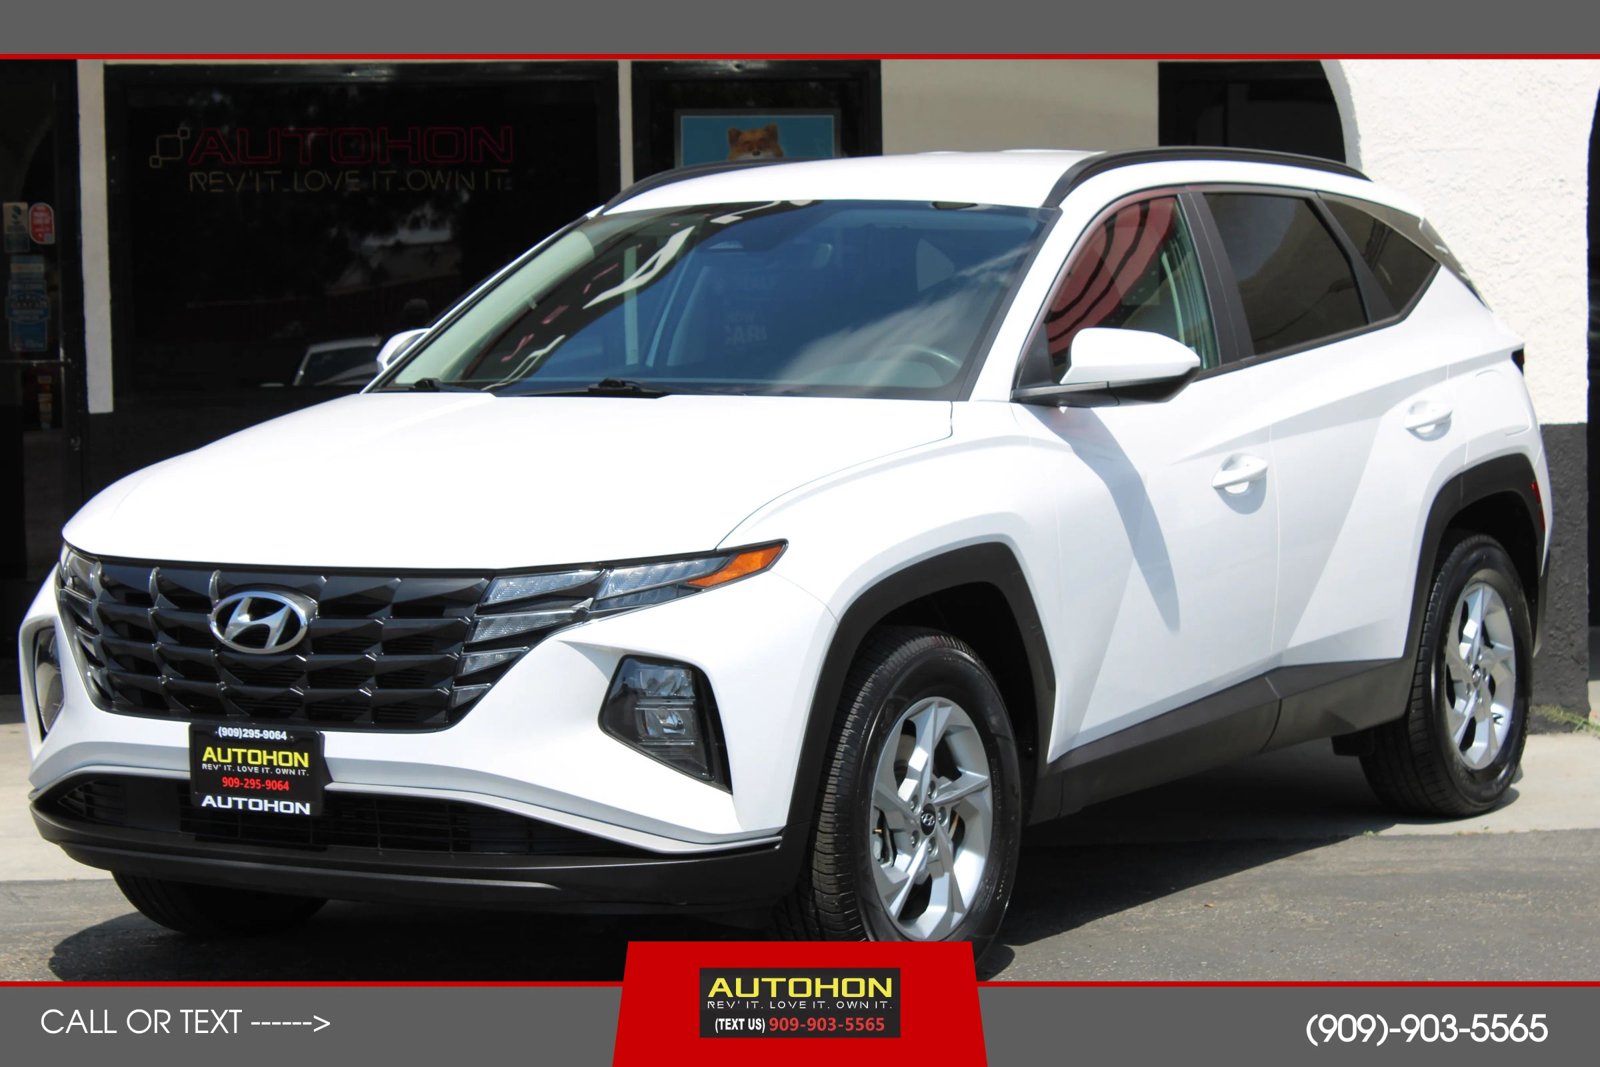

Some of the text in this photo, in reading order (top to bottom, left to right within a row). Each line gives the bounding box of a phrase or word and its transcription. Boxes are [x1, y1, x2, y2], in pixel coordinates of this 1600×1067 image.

[187, 126, 514, 165] AUTOHON
[293, 169, 360, 192] LOVE
[406, 169, 476, 191] OWN
[218, 726, 288, 741] (909)295-9064
[202, 746, 310, 768] AUTOHON
[237, 765, 259, 773] LOVE
[275, 768, 296, 776] OWN
[222, 776, 290, 791] 909-295-9064
[201, 795, 311, 815] AUTOHON
